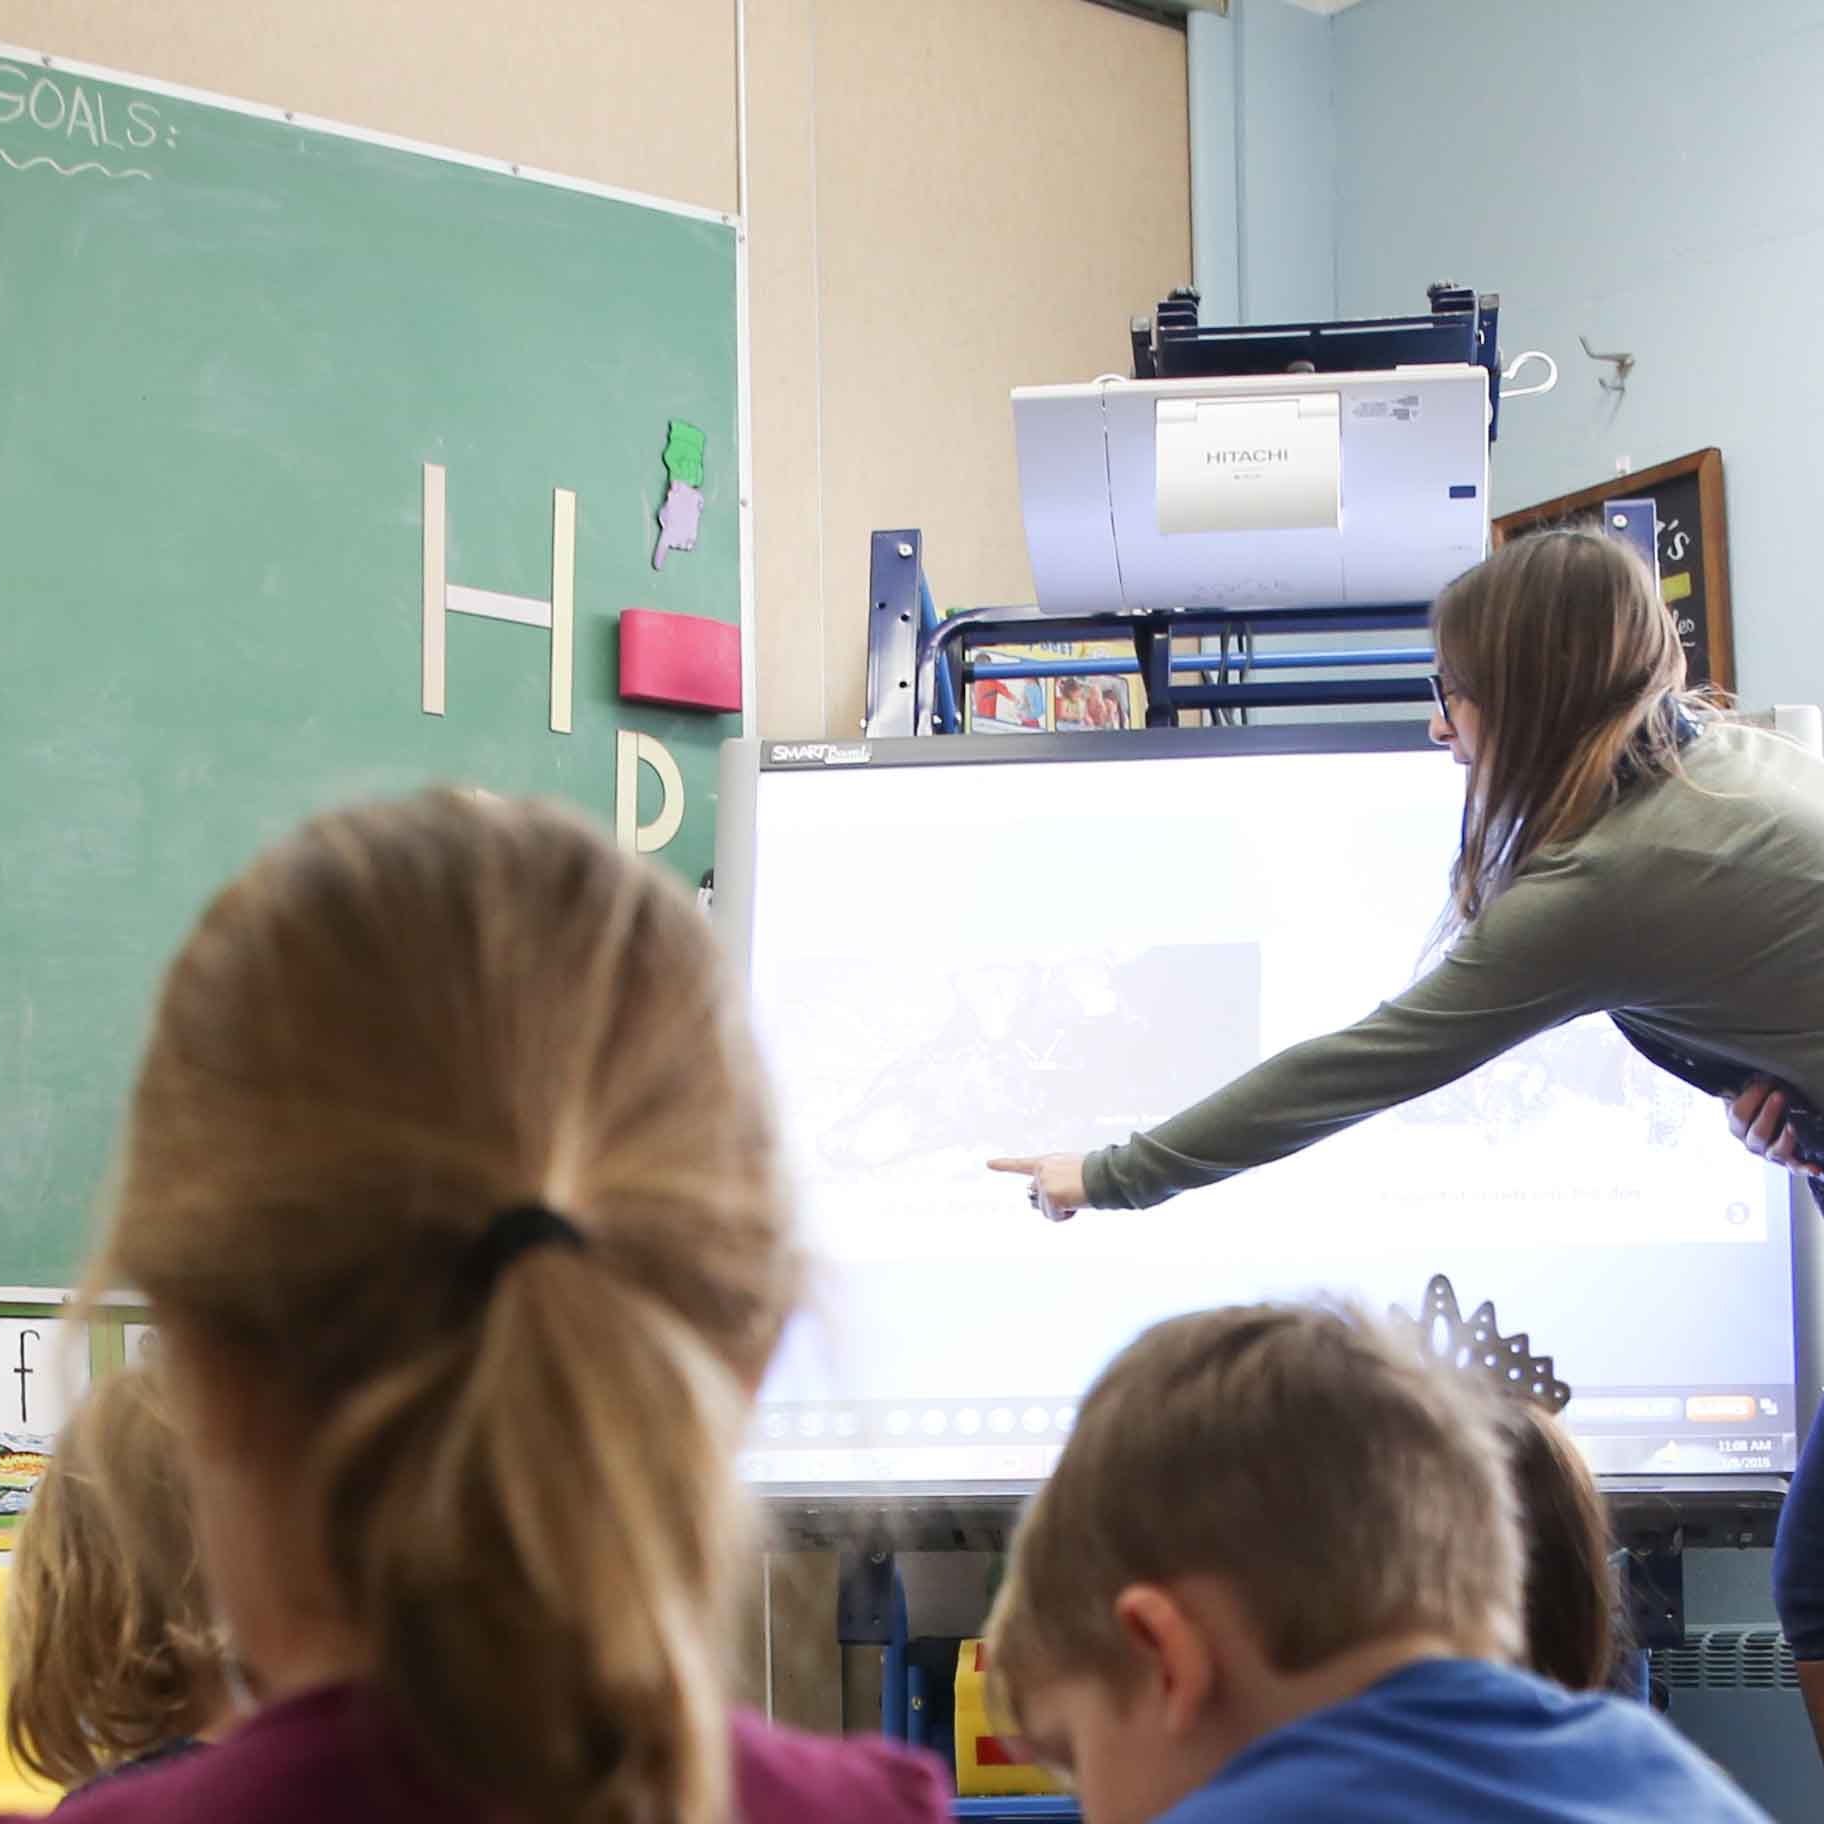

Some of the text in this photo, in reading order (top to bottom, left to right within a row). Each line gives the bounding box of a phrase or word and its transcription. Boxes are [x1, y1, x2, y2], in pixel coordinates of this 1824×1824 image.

[1207, 449, 1288, 464] HITACHI
[422, 463, 576, 735] H
[773, 744, 829, 761] SMART
